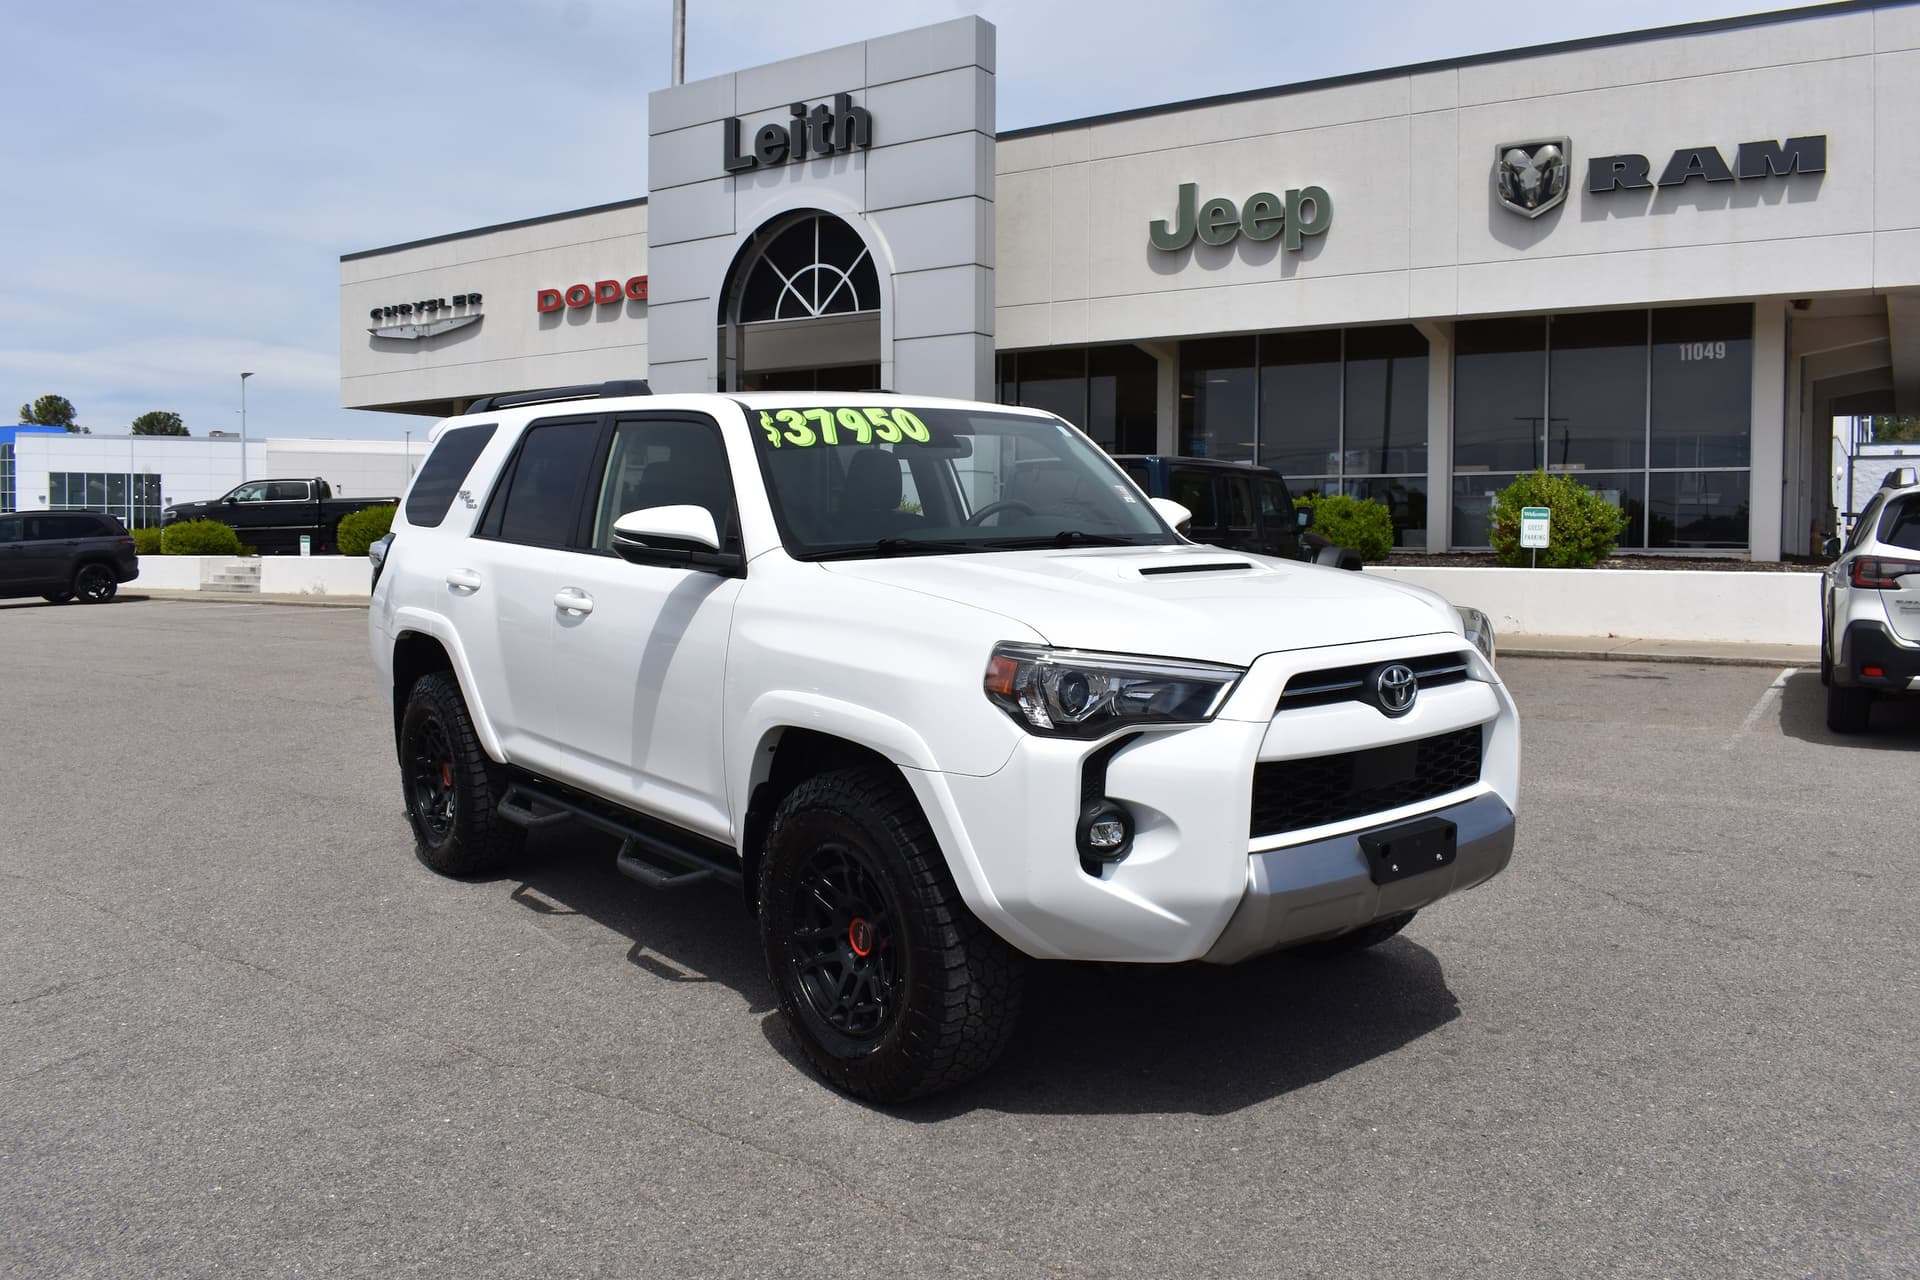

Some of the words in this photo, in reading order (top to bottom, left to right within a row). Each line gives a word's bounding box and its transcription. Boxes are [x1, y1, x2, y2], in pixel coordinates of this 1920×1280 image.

[723, 92, 873, 172] Leith
[1588, 134, 1827, 193] RAM
[1149, 182, 1333, 252] Jeep
[370, 292, 483, 320] CHRYSLER
[1679, 341, 1726, 361] 11049
[759, 408, 930, 448] $37950
